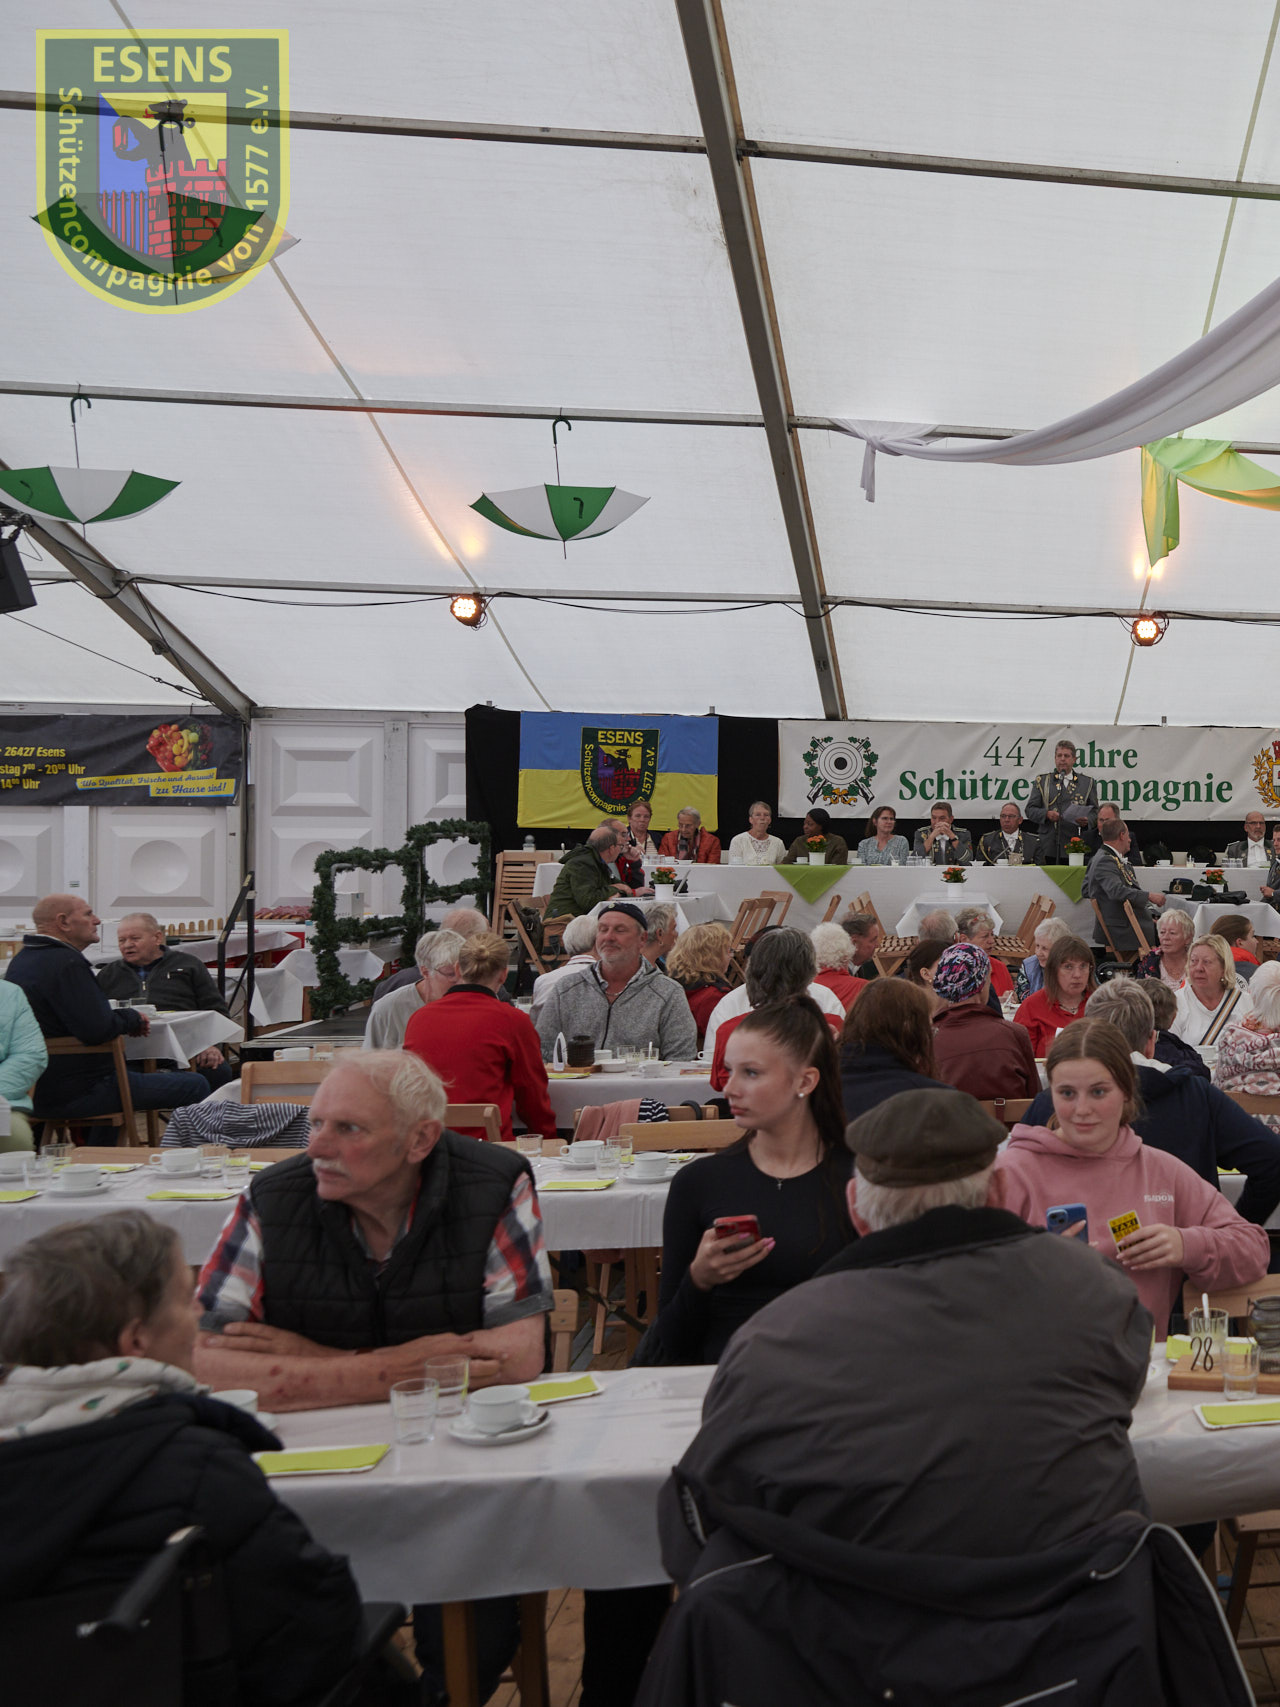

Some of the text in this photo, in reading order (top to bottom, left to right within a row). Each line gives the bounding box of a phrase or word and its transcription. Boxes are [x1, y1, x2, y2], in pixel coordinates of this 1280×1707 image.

[598, 730, 644, 745] ESENS
[4, 746, 66, 757] 26427 Esens
[983, 736, 1138, 769] 447 ahre
[68, 763, 86, 775] Uhr
[22, 778, 40, 789] Uhr
[584, 743, 627, 813] Schützencompagnie
[642, 771, 654, 795] 1577
[172, 784, 205, 794] Hause
[899, 768, 1233, 812] Schützempagnie
[1190, 1336, 1214, 1372] 28
